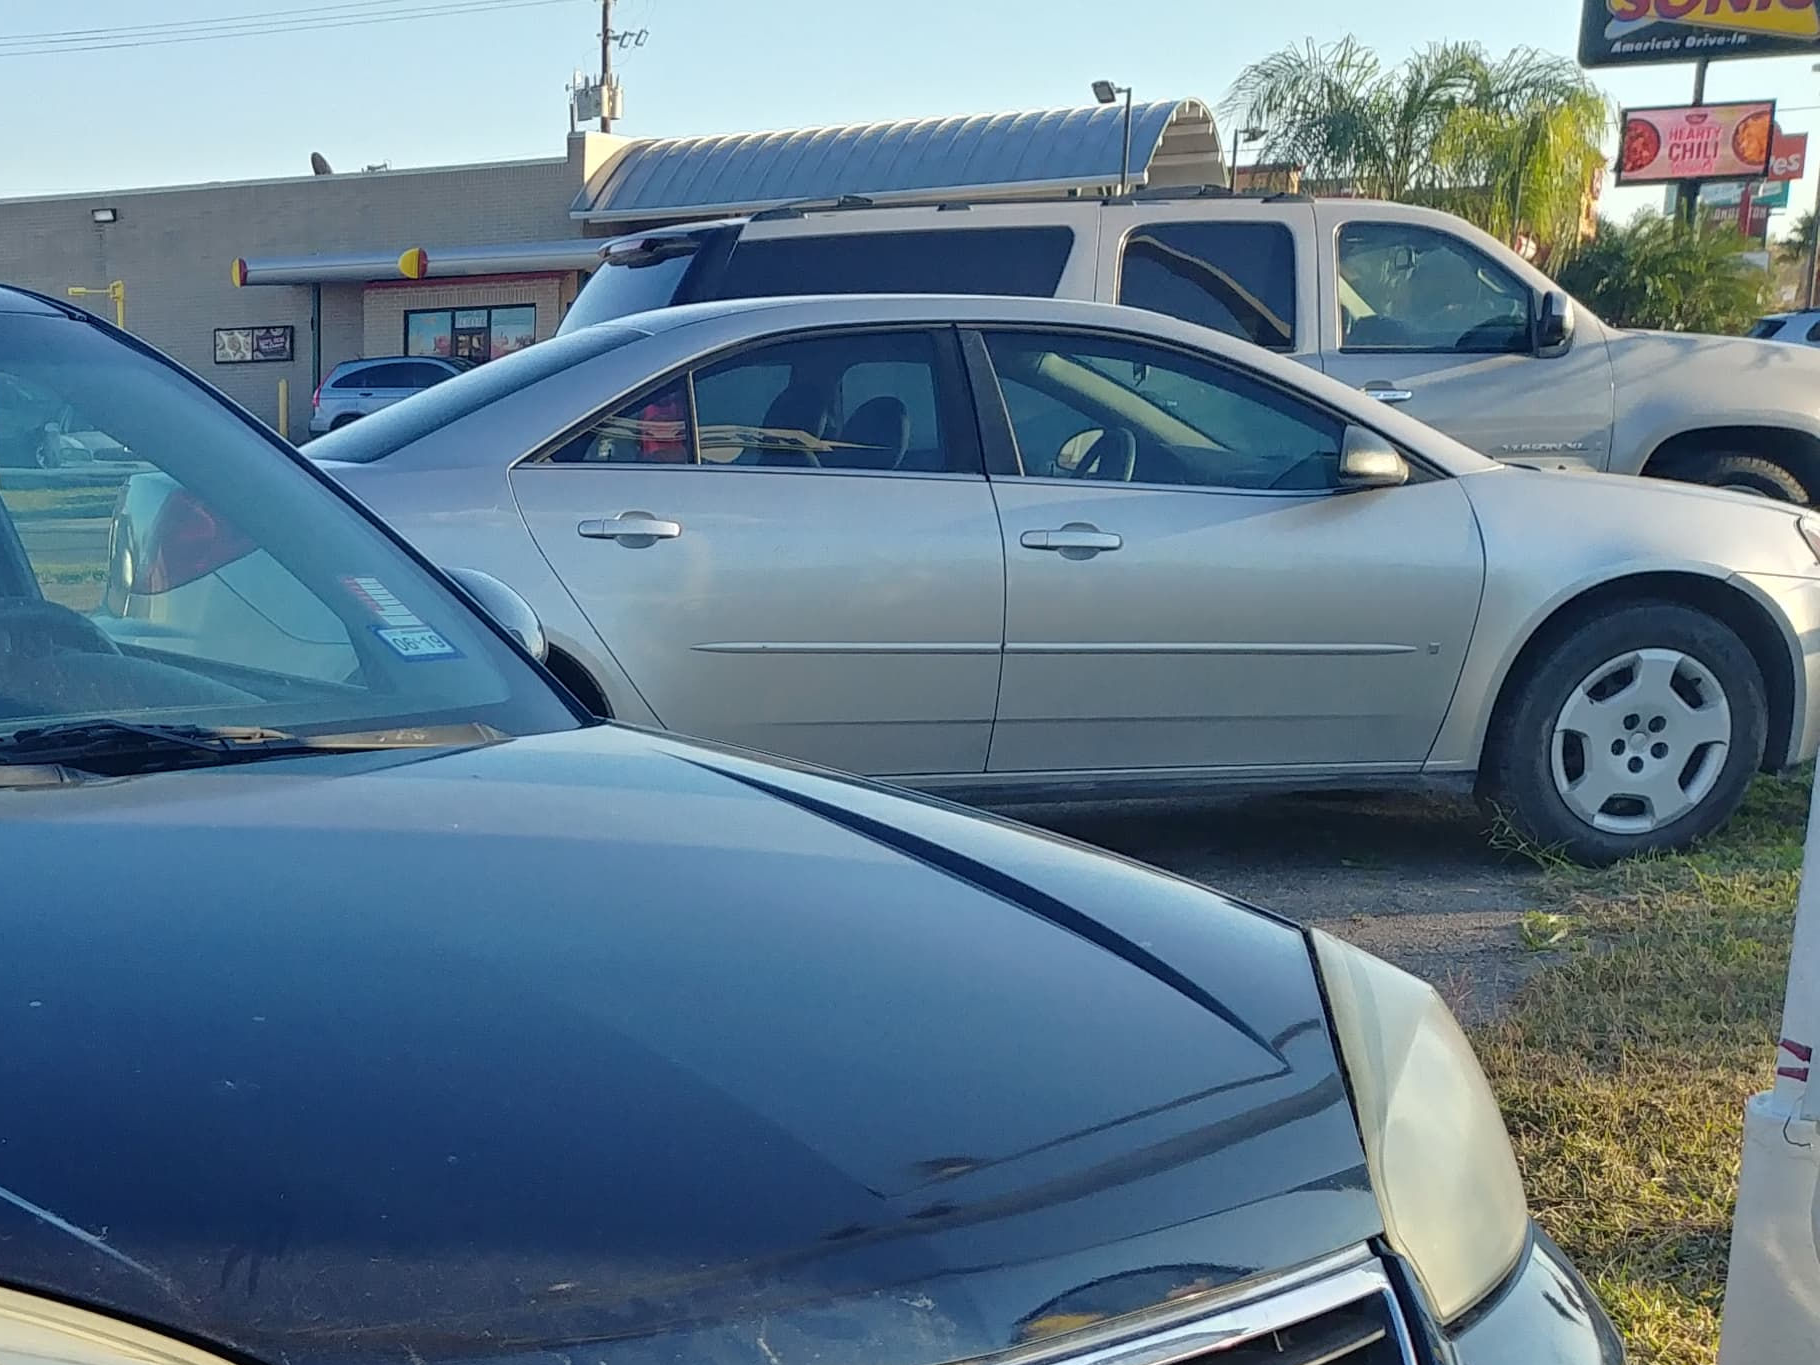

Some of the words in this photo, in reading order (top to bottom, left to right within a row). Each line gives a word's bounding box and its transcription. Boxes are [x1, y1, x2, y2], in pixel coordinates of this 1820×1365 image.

[1611, 37, 1681, 53] America's
[1685, 32, 1748, 48] Drive-In
[1668, 126, 1722, 141] HEARTY
[1667, 141, 1720, 160] CHILI
